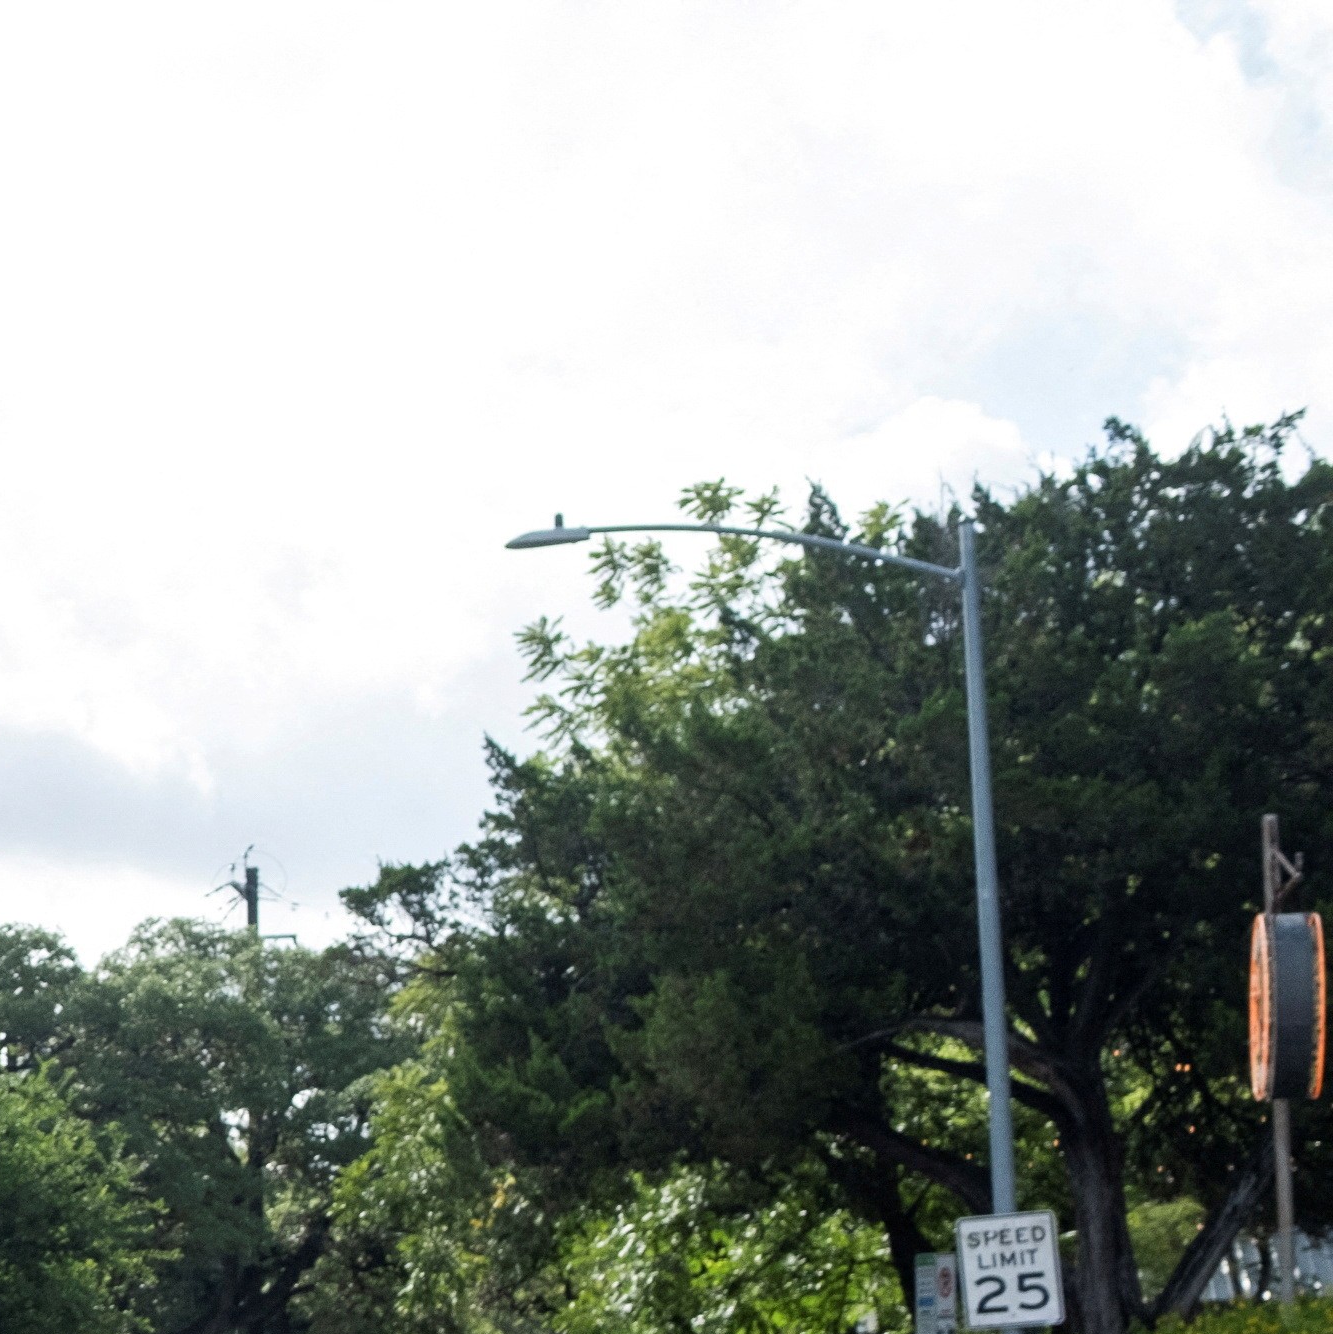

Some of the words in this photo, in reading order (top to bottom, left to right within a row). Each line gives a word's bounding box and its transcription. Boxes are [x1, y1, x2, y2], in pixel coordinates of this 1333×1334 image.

[966, 1225, 1046, 1249] SPEED
[977, 1249, 1039, 1270] LIMIT
[974, 1271, 1050, 1315] 25
